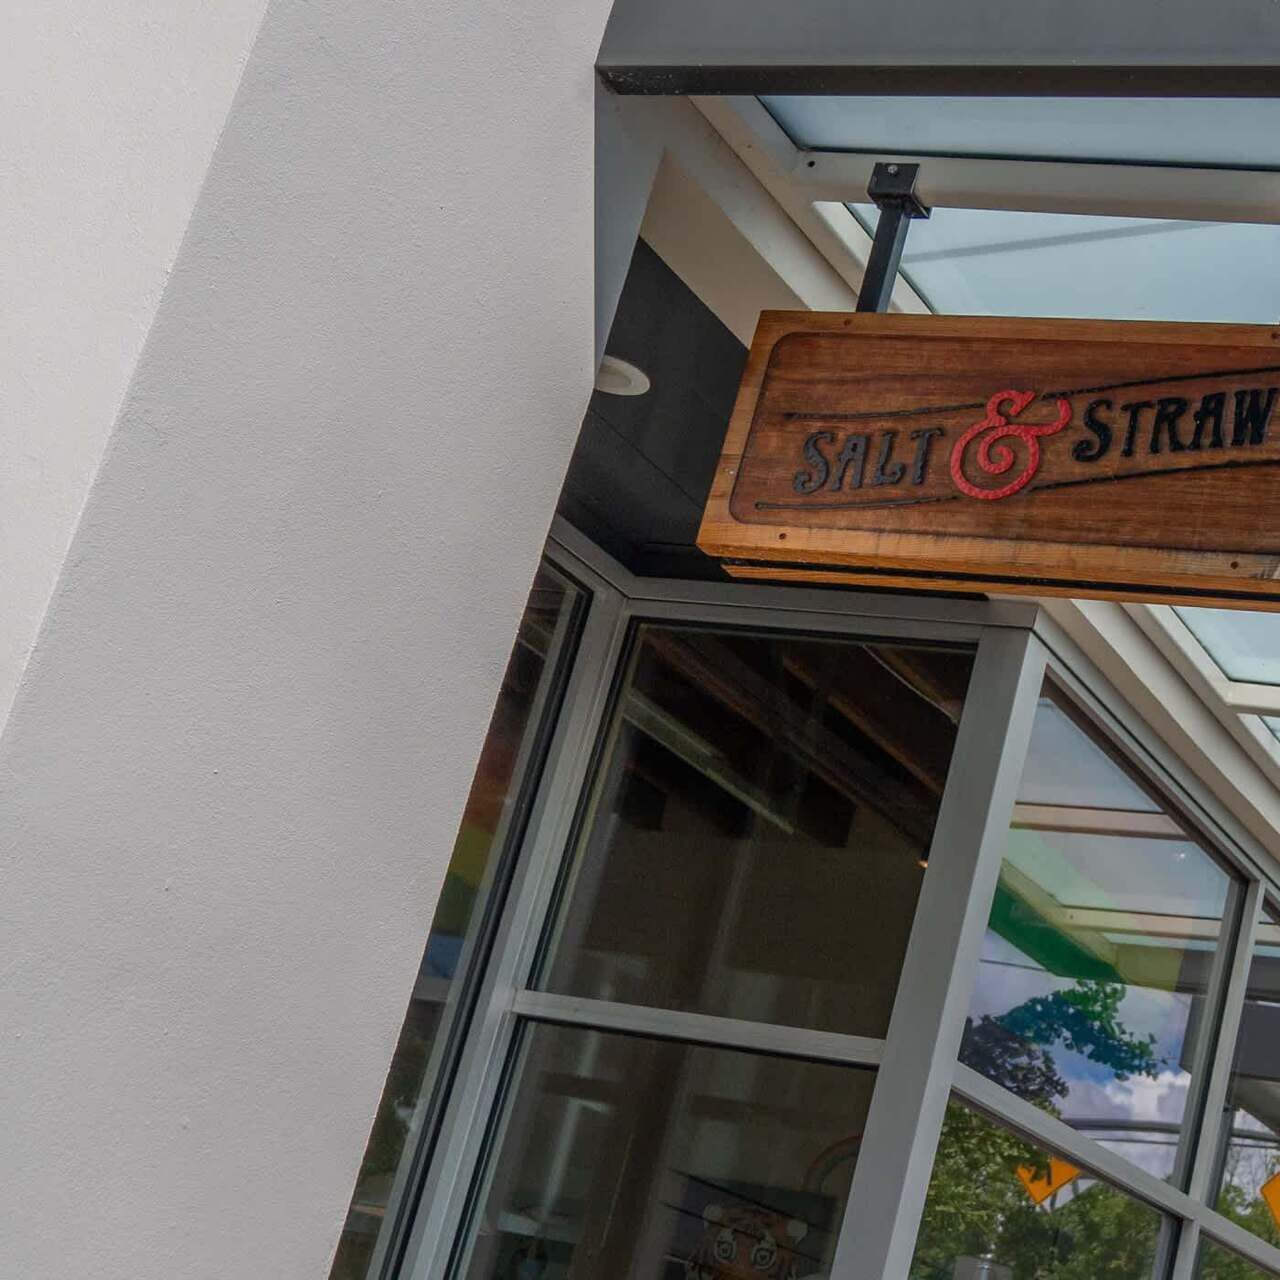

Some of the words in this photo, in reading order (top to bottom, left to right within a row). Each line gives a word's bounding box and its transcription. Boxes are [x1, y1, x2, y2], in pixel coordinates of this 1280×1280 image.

[792, 426, 945, 496] SALT
[950, 389, 1073, 500] &
[1071, 386, 1280, 463] STRAW
